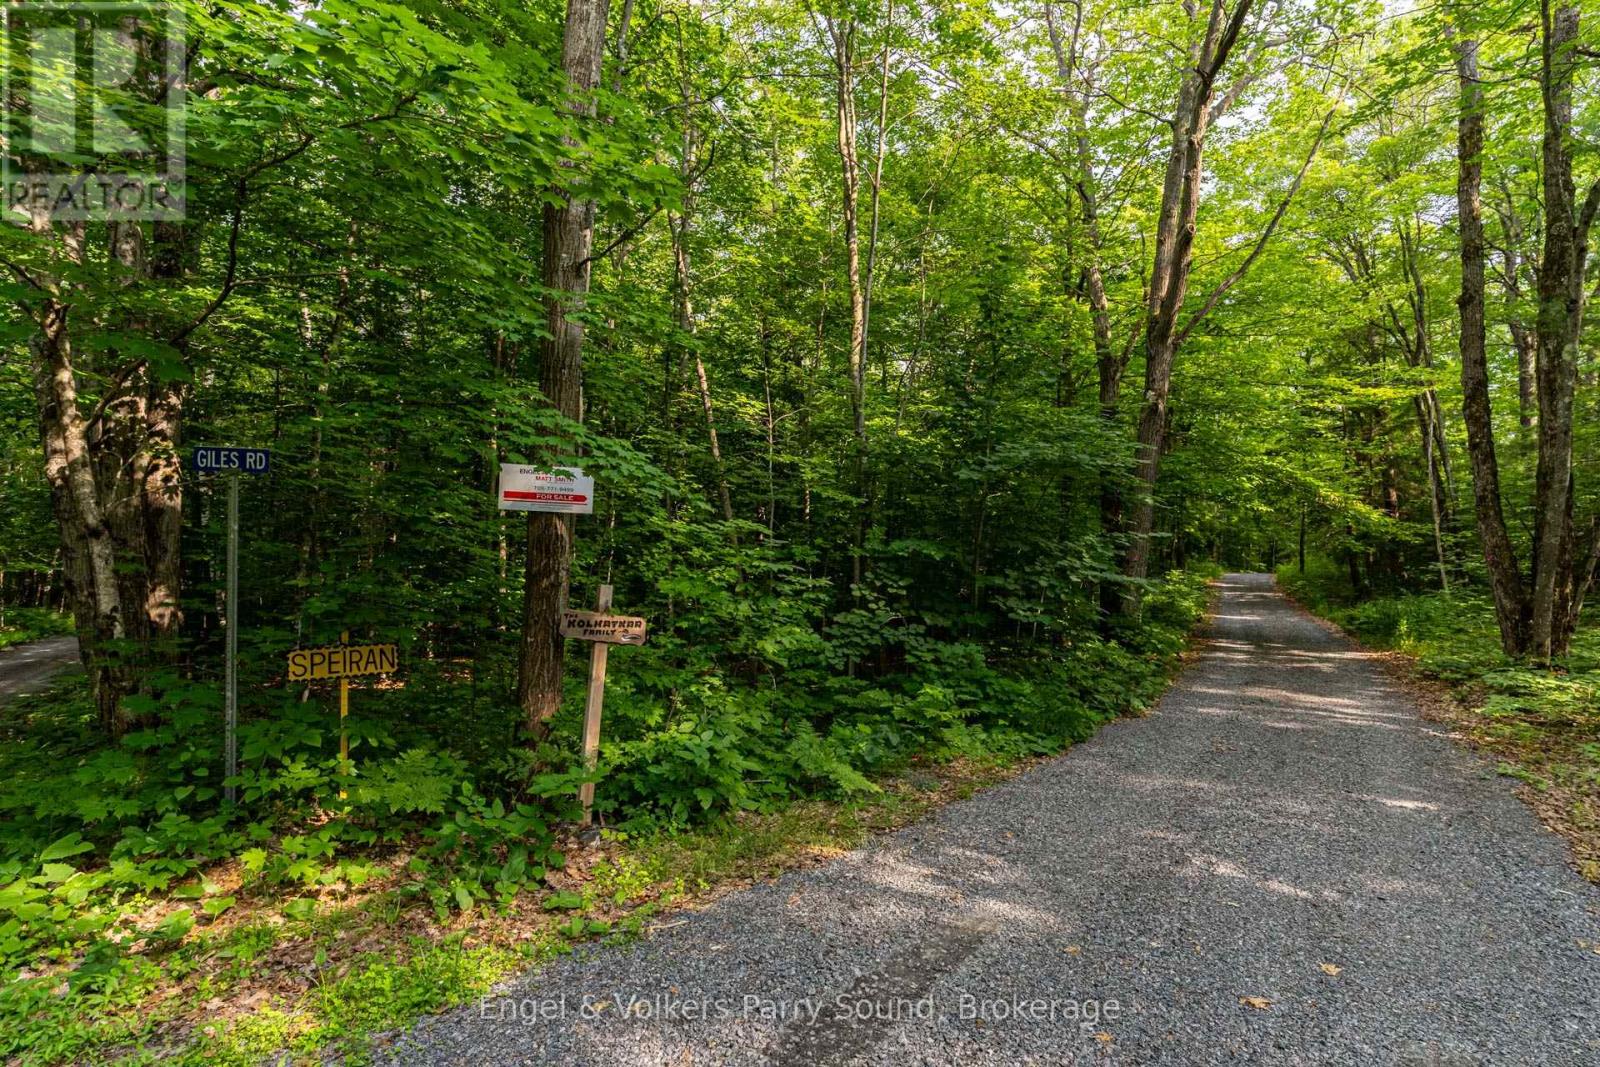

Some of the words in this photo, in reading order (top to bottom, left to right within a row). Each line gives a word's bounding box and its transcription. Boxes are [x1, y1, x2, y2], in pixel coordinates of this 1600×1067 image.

[197, 449, 239, 468] GILES
[246, 452, 266, 470] RD
[583, 628, 616, 636] FAMILY
[291, 647, 395, 677] SPEIRAN
